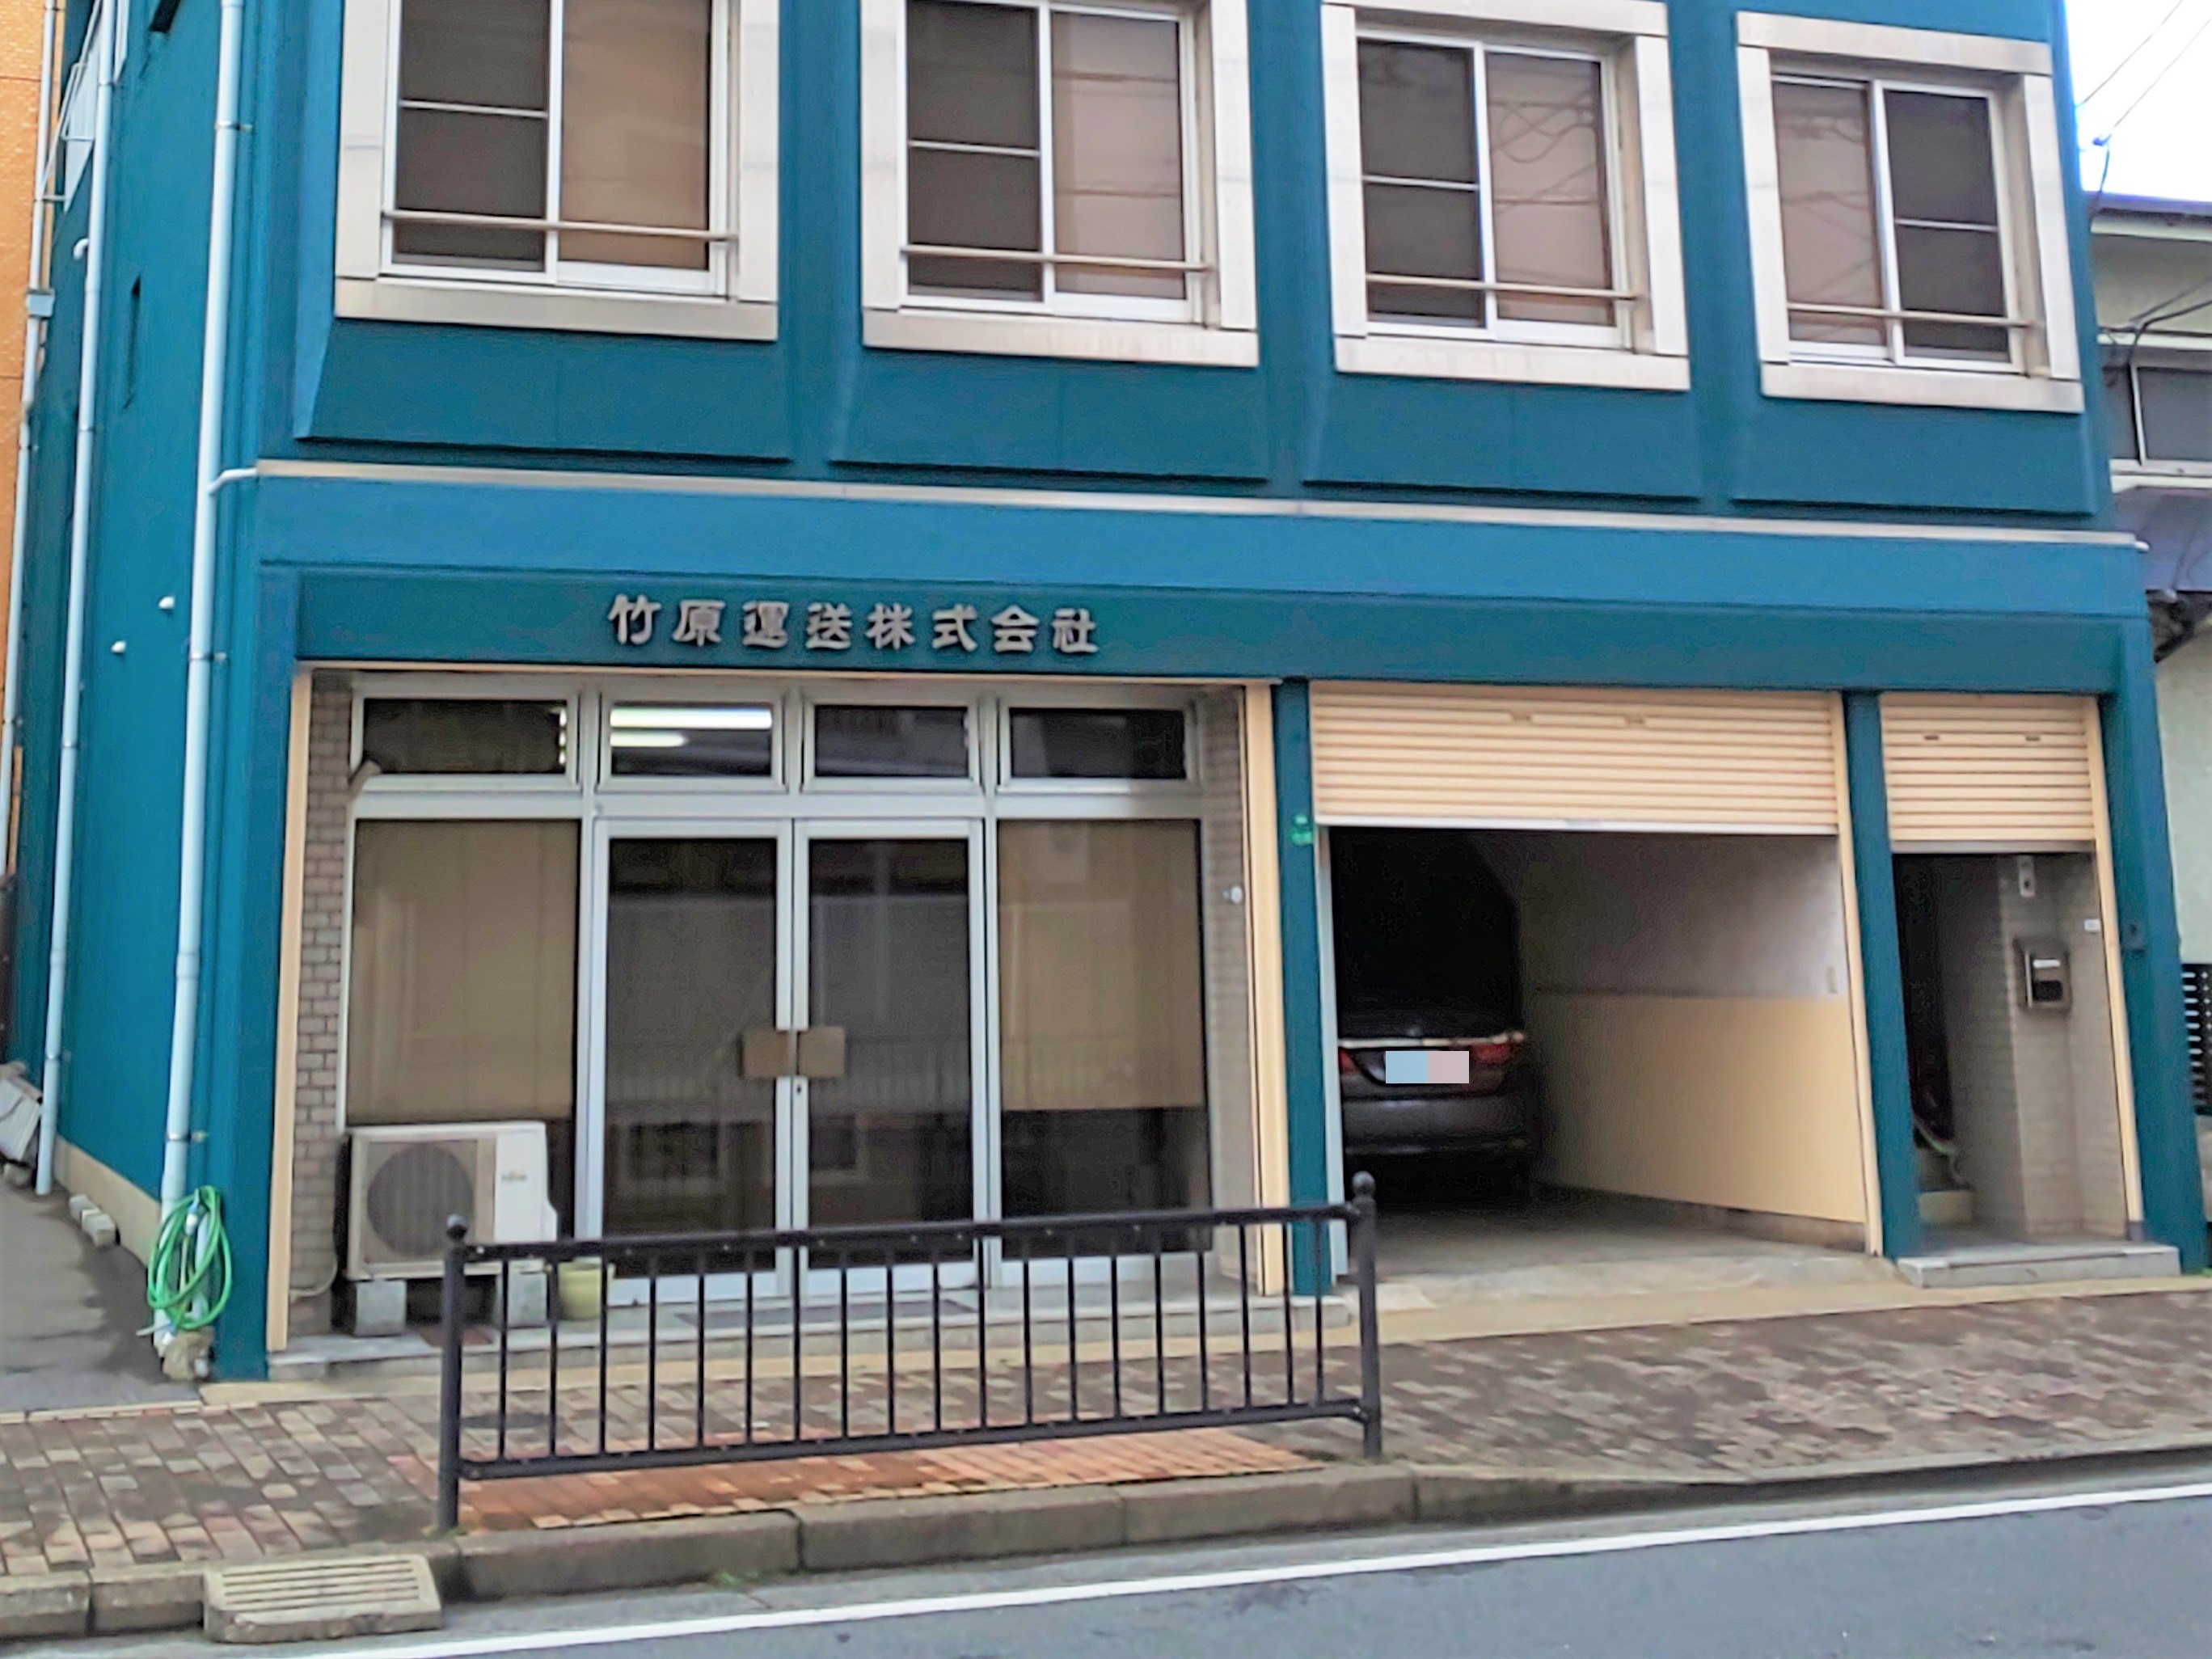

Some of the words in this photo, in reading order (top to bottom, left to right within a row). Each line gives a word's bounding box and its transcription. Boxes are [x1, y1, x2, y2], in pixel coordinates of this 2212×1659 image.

[608, 593, 1098, 653] 竹原運送株式会社
